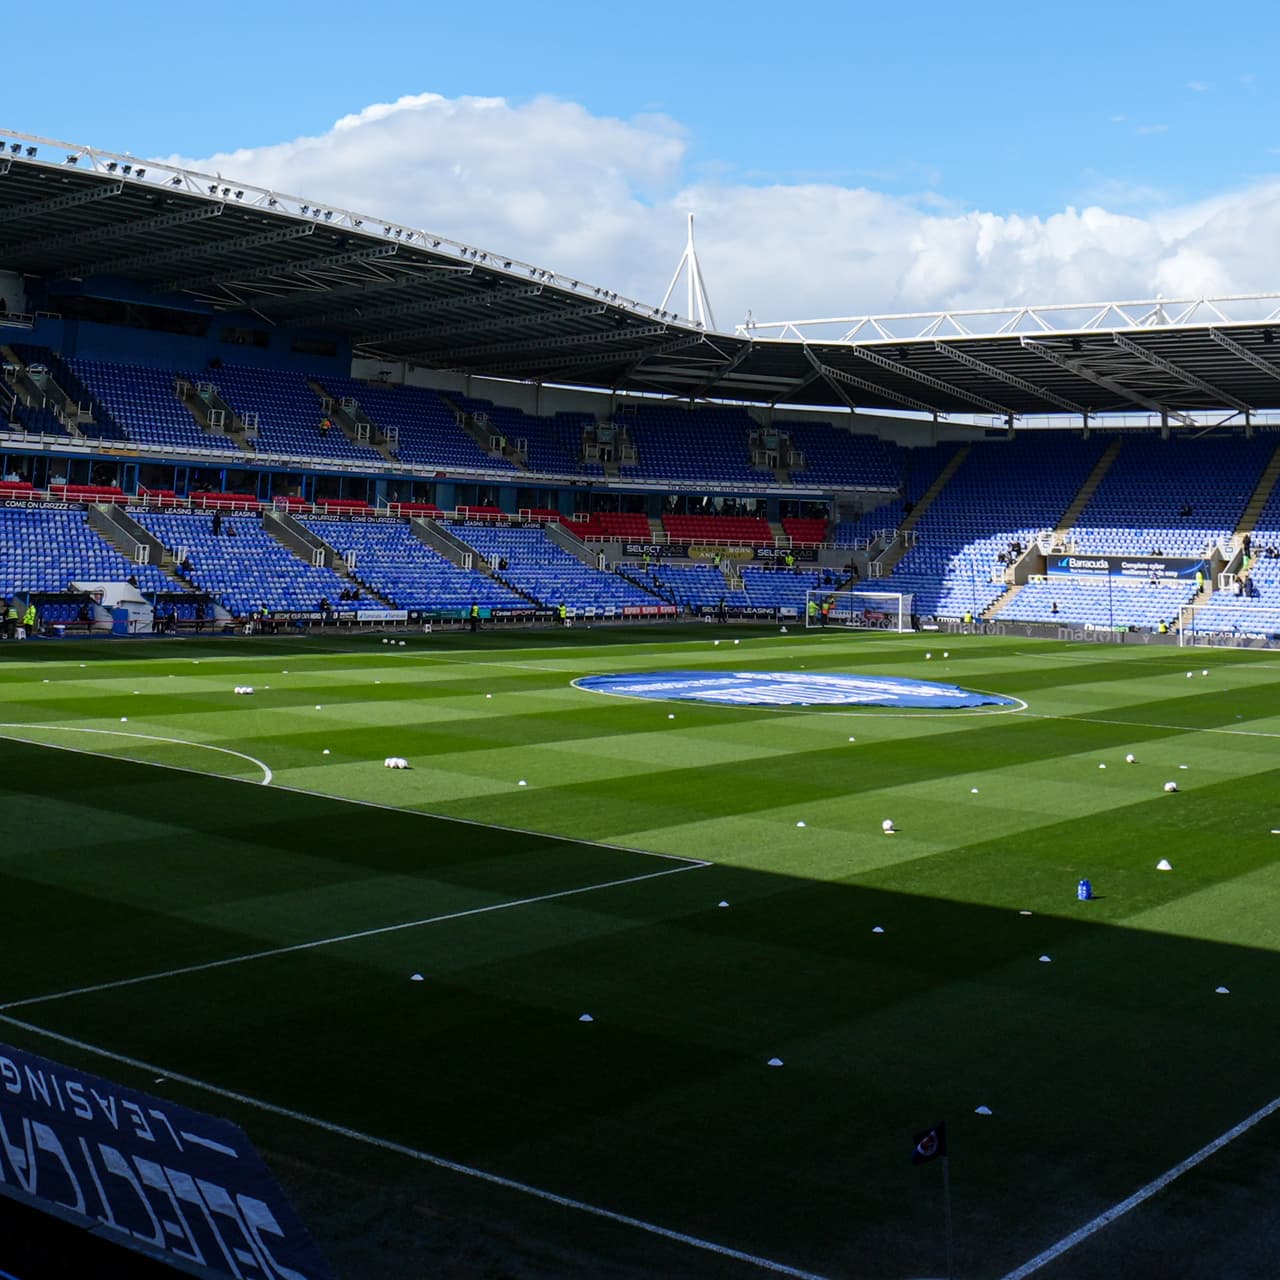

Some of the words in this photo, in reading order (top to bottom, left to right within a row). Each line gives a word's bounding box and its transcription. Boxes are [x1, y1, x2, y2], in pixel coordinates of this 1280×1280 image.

[5, 500, 26, 508] COME
[27, 501, 38, 509] ON
[626, 545, 662, 553] SELECT
[757, 548, 792, 557] SELECT
[1069, 558, 1109, 568] Barracuda
